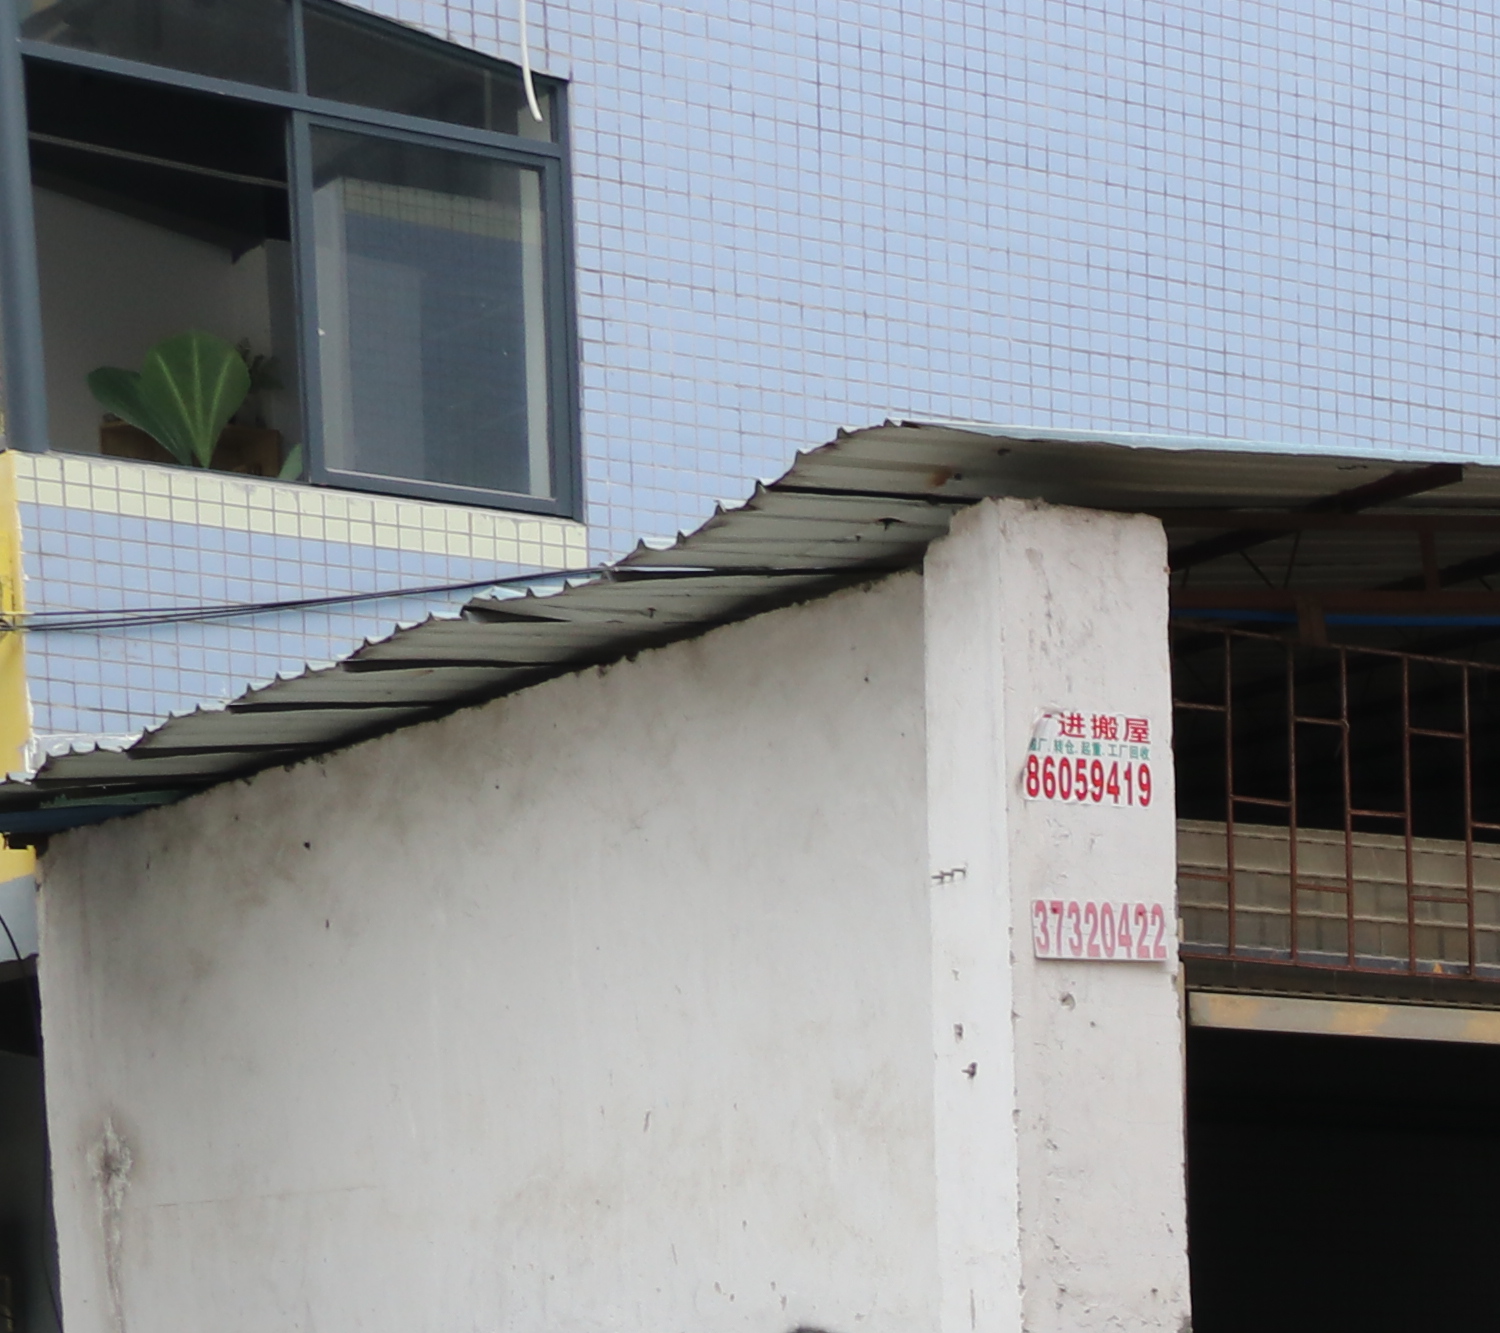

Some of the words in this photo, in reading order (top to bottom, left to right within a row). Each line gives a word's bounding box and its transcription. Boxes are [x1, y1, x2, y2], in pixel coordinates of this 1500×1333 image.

[1043, 713, 1152, 744] 进搬屋
[1026, 754, 1152, 807] 86059419
[1034, 900, 1168, 959] 37320422
